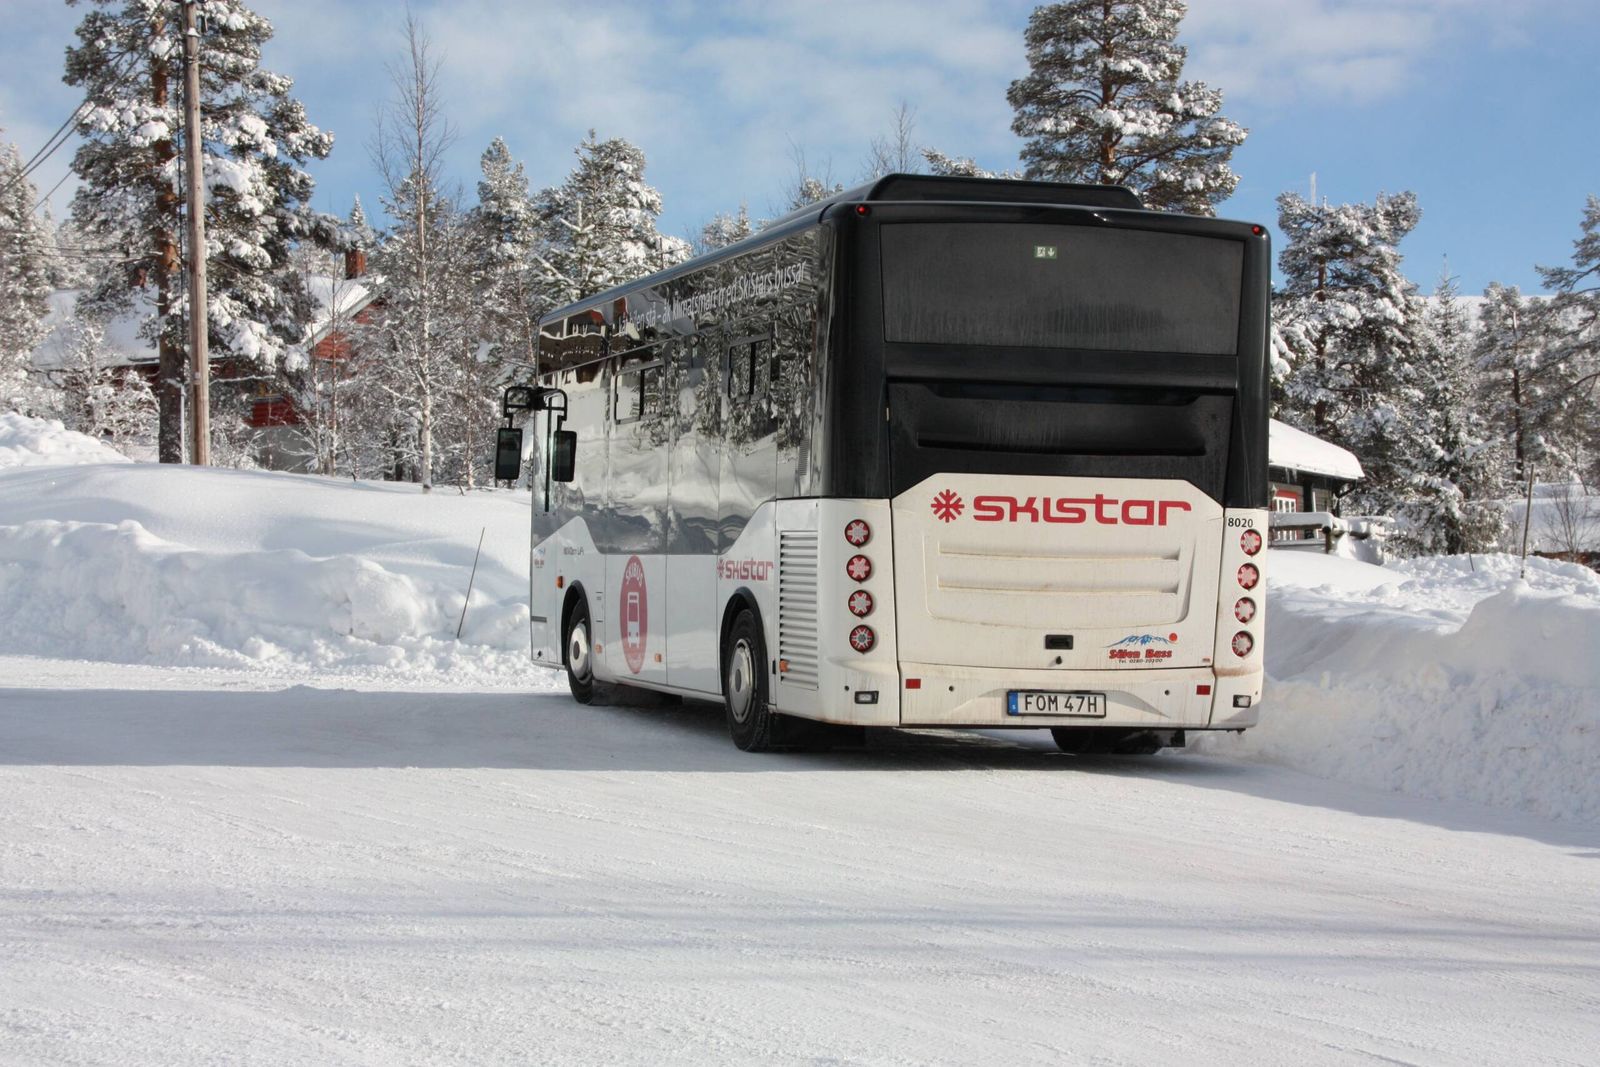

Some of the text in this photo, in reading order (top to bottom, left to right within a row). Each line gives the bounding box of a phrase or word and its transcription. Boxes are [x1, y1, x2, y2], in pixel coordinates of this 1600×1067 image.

[774, 261, 806, 290] bussar
[1227, 516, 1254, 528] 8020
[1024, 694, 1098, 713] FOM 47H
